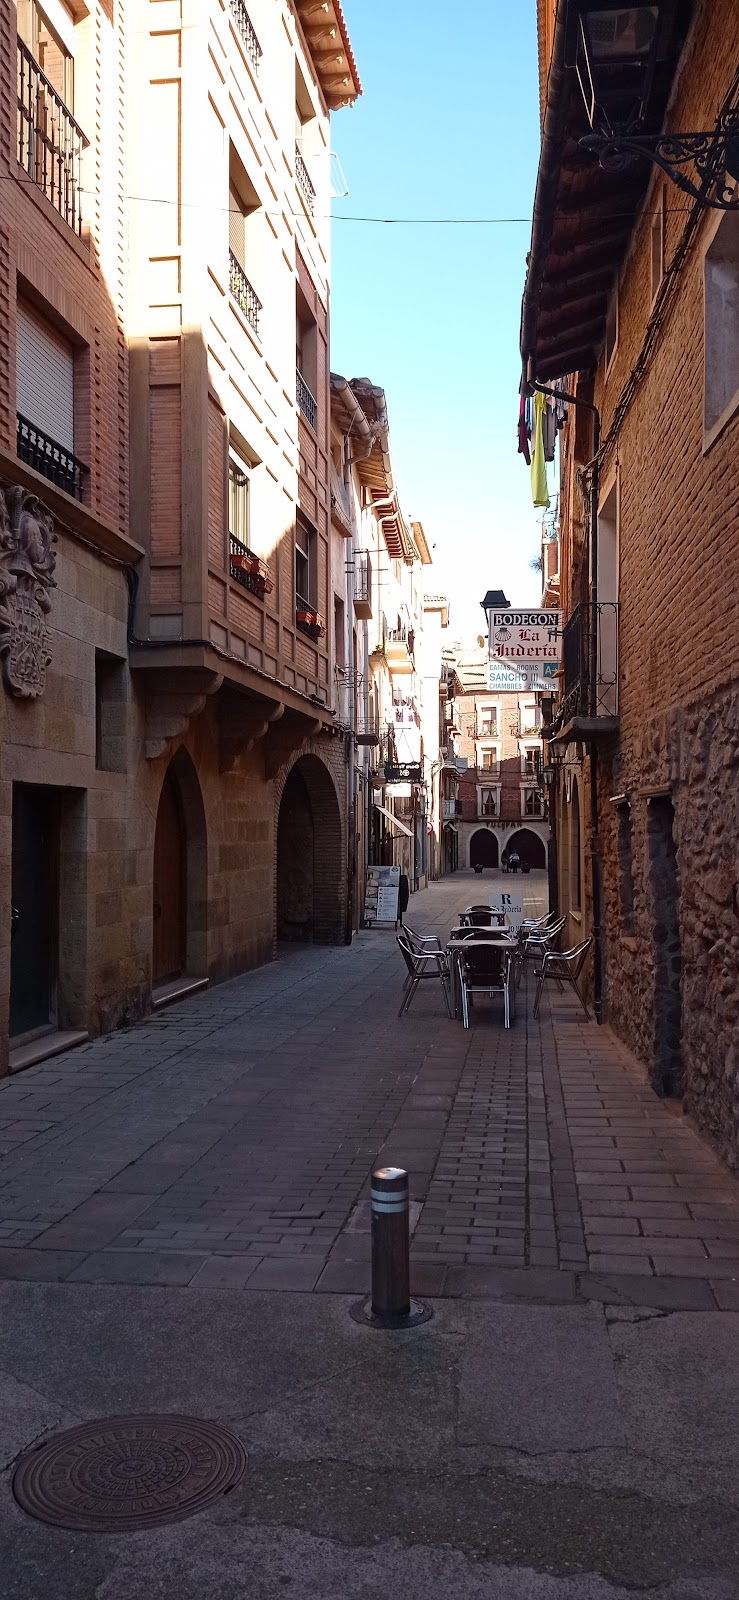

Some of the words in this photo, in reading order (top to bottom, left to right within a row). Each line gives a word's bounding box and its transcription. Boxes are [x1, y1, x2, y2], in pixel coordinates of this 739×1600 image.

[495, 614, 556, 625] BODEGON
[519, 629, 540, 641] La
[493, 643, 557, 657] Judería
[489, 672, 528, 682] SANCHO
[530, 673, 539, 682] III
